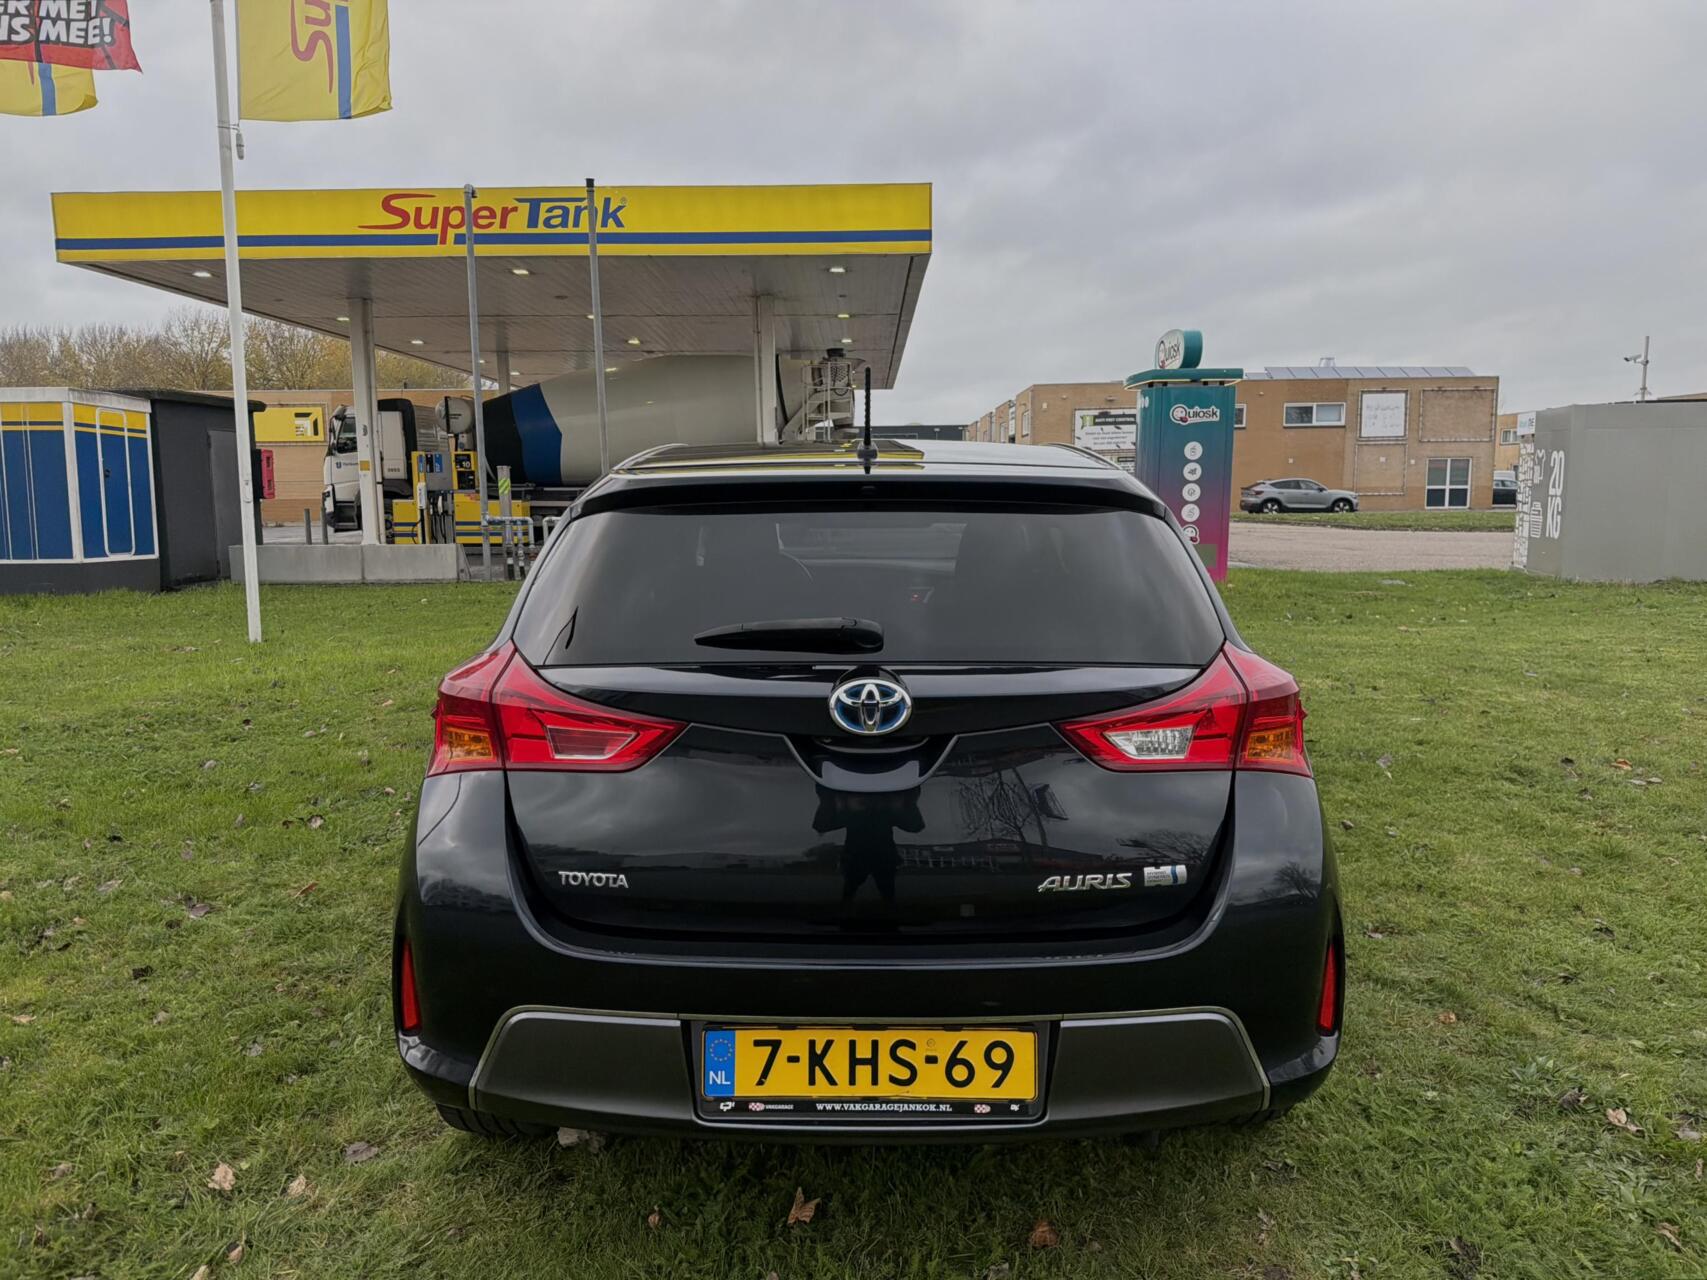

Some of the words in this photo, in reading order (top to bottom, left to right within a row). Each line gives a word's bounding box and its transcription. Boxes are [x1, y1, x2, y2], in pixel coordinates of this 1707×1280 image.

[38, 18, 112, 45] MEE!
[357, 193, 626, 245] SuperTank
[1171, 406, 1219, 423] Quiosk
[1549, 450, 1565, 495] 20
[1545, 496, 1562, 539] KG
[558, 870, 629, 889] TOYOTA
[1037, 872, 1133, 893] AURIS
[752, 1038, 1015, 1089] 7-KHS-69
[709, 1071, 731, 1086] NL
[815, 1103, 953, 1113] WWW.VAKGARAGEJANKOK.NL
